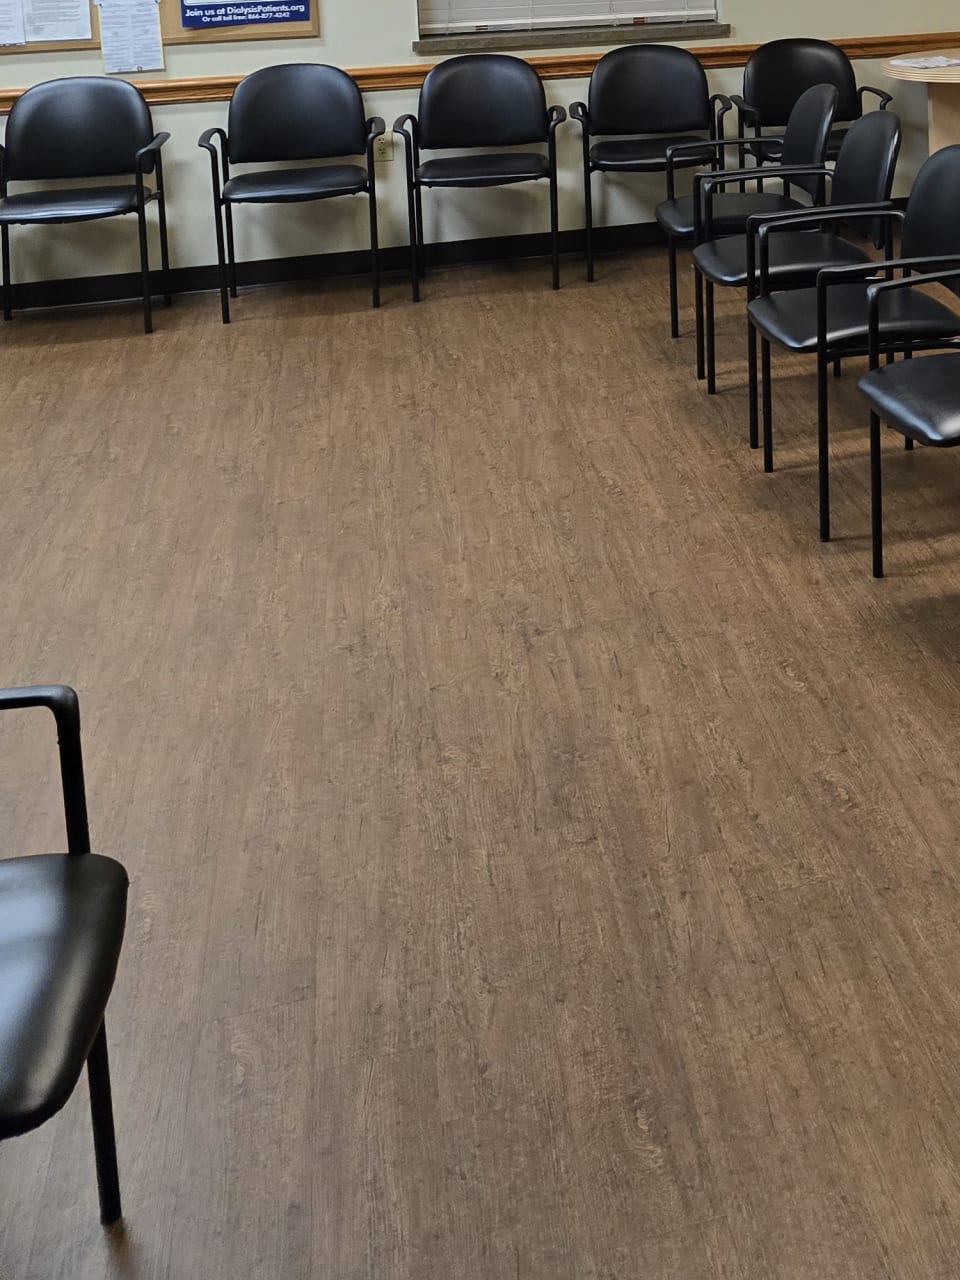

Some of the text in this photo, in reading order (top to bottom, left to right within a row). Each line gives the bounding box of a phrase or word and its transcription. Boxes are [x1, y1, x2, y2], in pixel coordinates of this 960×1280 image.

[185, 4, 305, 17] Join us at DialysisPatients.org
